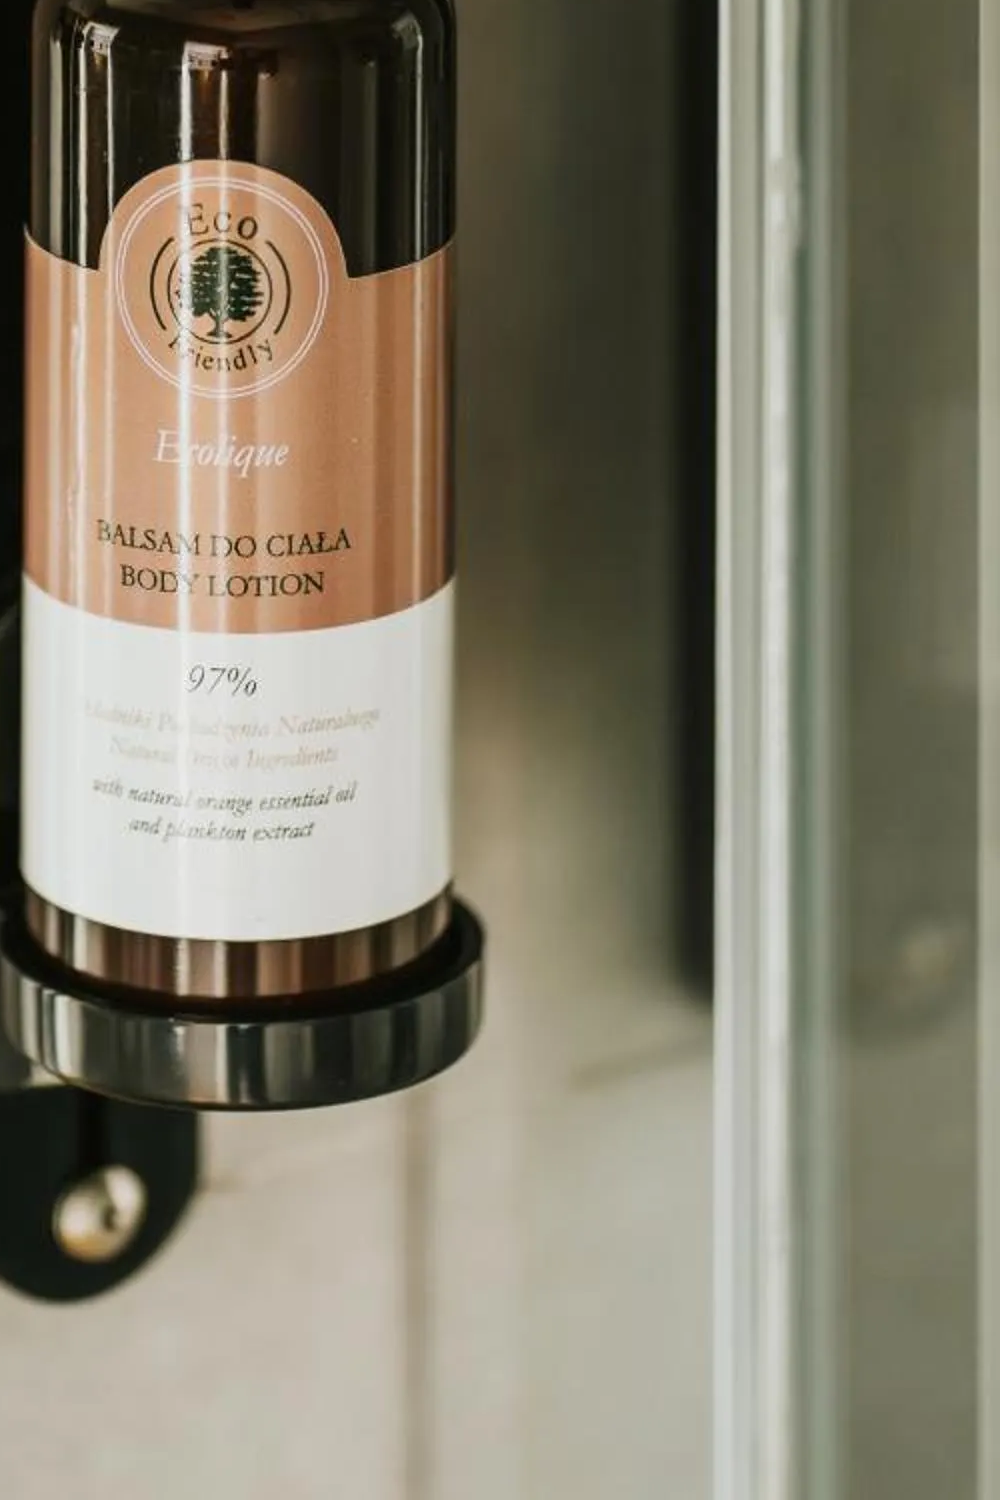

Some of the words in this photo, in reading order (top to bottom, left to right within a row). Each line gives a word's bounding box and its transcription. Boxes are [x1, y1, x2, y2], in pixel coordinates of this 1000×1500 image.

[168, 338, 273, 372] iendly
[97, 518, 201, 556] BALSAM
[211, 535, 257, 558] DO
[266, 528, 352, 557] CIAŁA
[120, 563, 200, 596] BODY
[208, 571, 325, 598] LOTION
[186, 664, 258, 697] 97%
[129, 815, 162, 836] and
[252, 821, 317, 844] extract
